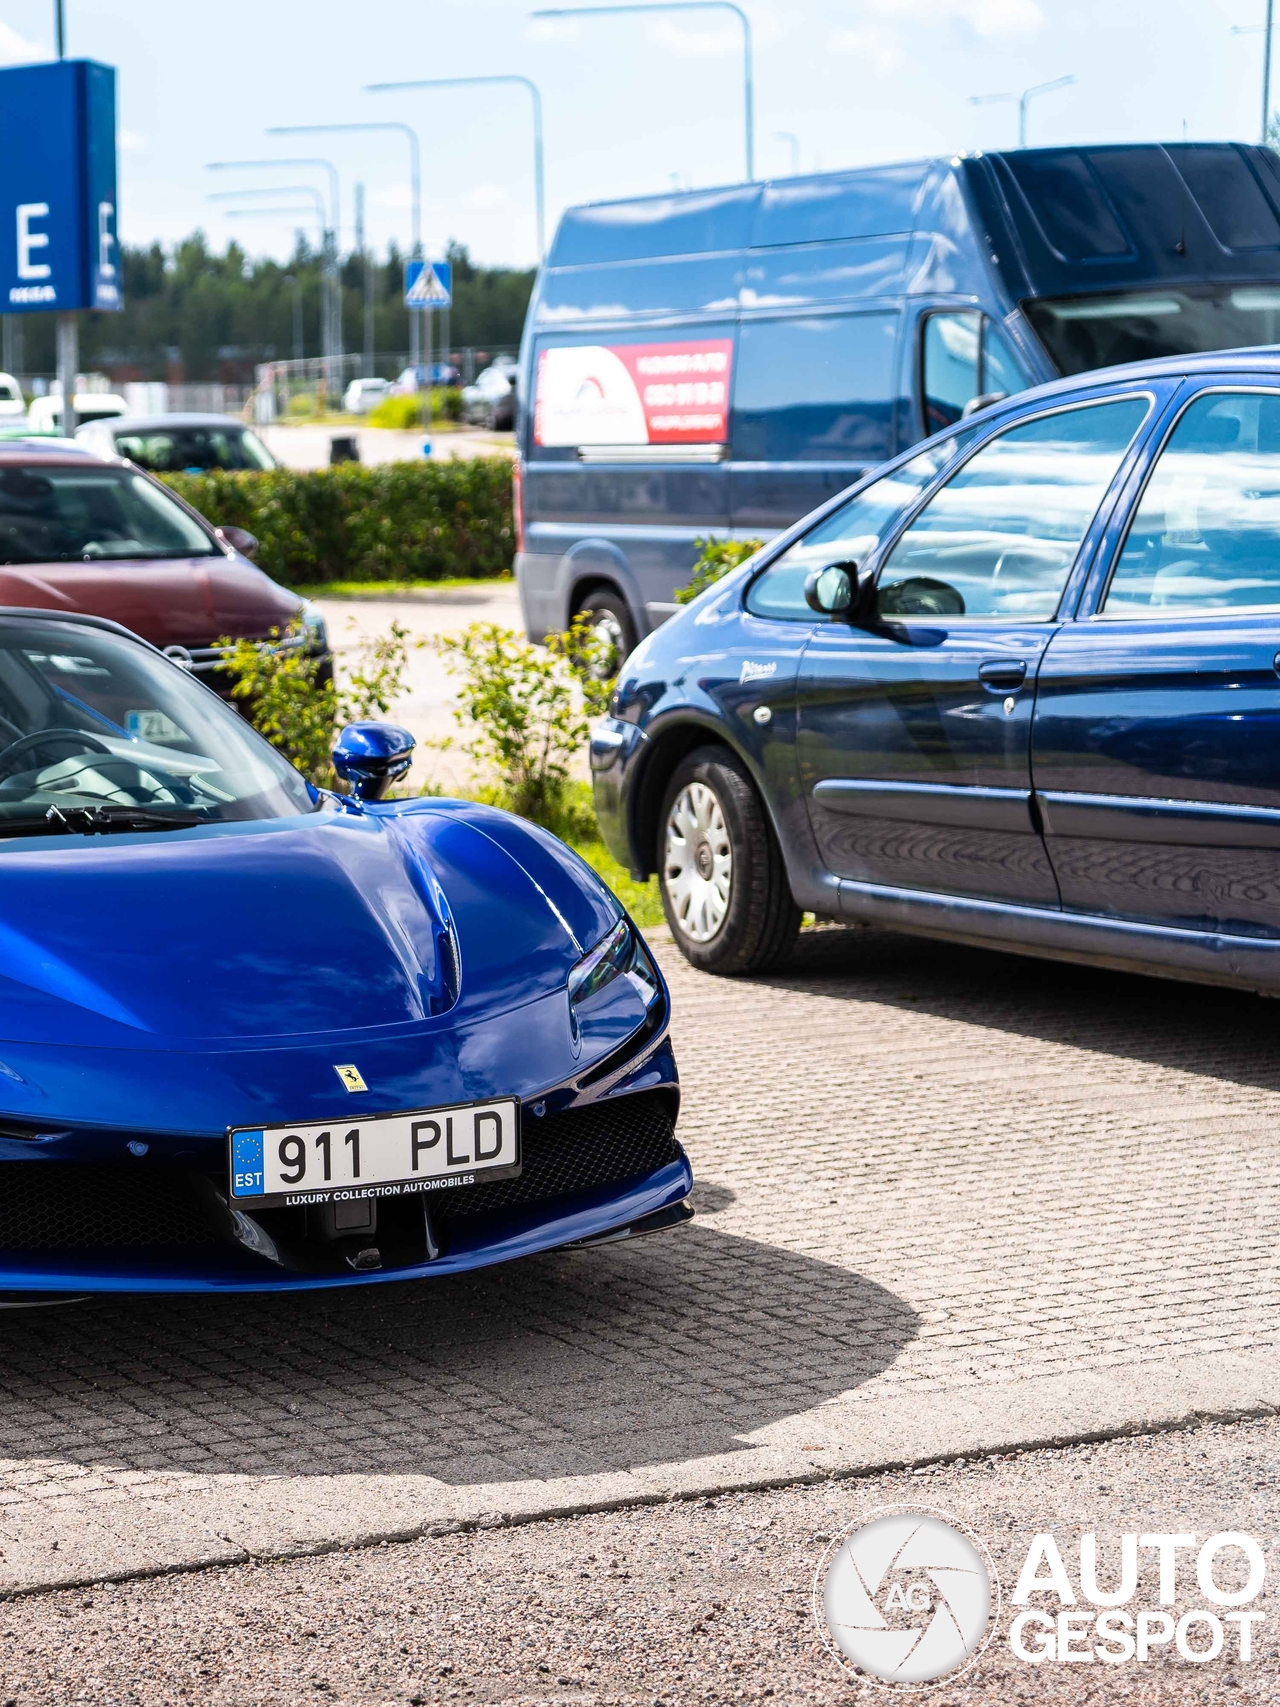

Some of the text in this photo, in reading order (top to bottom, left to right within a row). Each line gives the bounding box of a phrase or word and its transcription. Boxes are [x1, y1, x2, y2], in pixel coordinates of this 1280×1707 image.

[16, 202, 51, 279] E
[98, 201, 115, 278] E
[235, 1172, 262, 1187] EST
[278, 1111, 503, 1184] 911 PLD
[286, 1175, 475, 1206] LUXURY COLLECTION AUTOMOBILES
